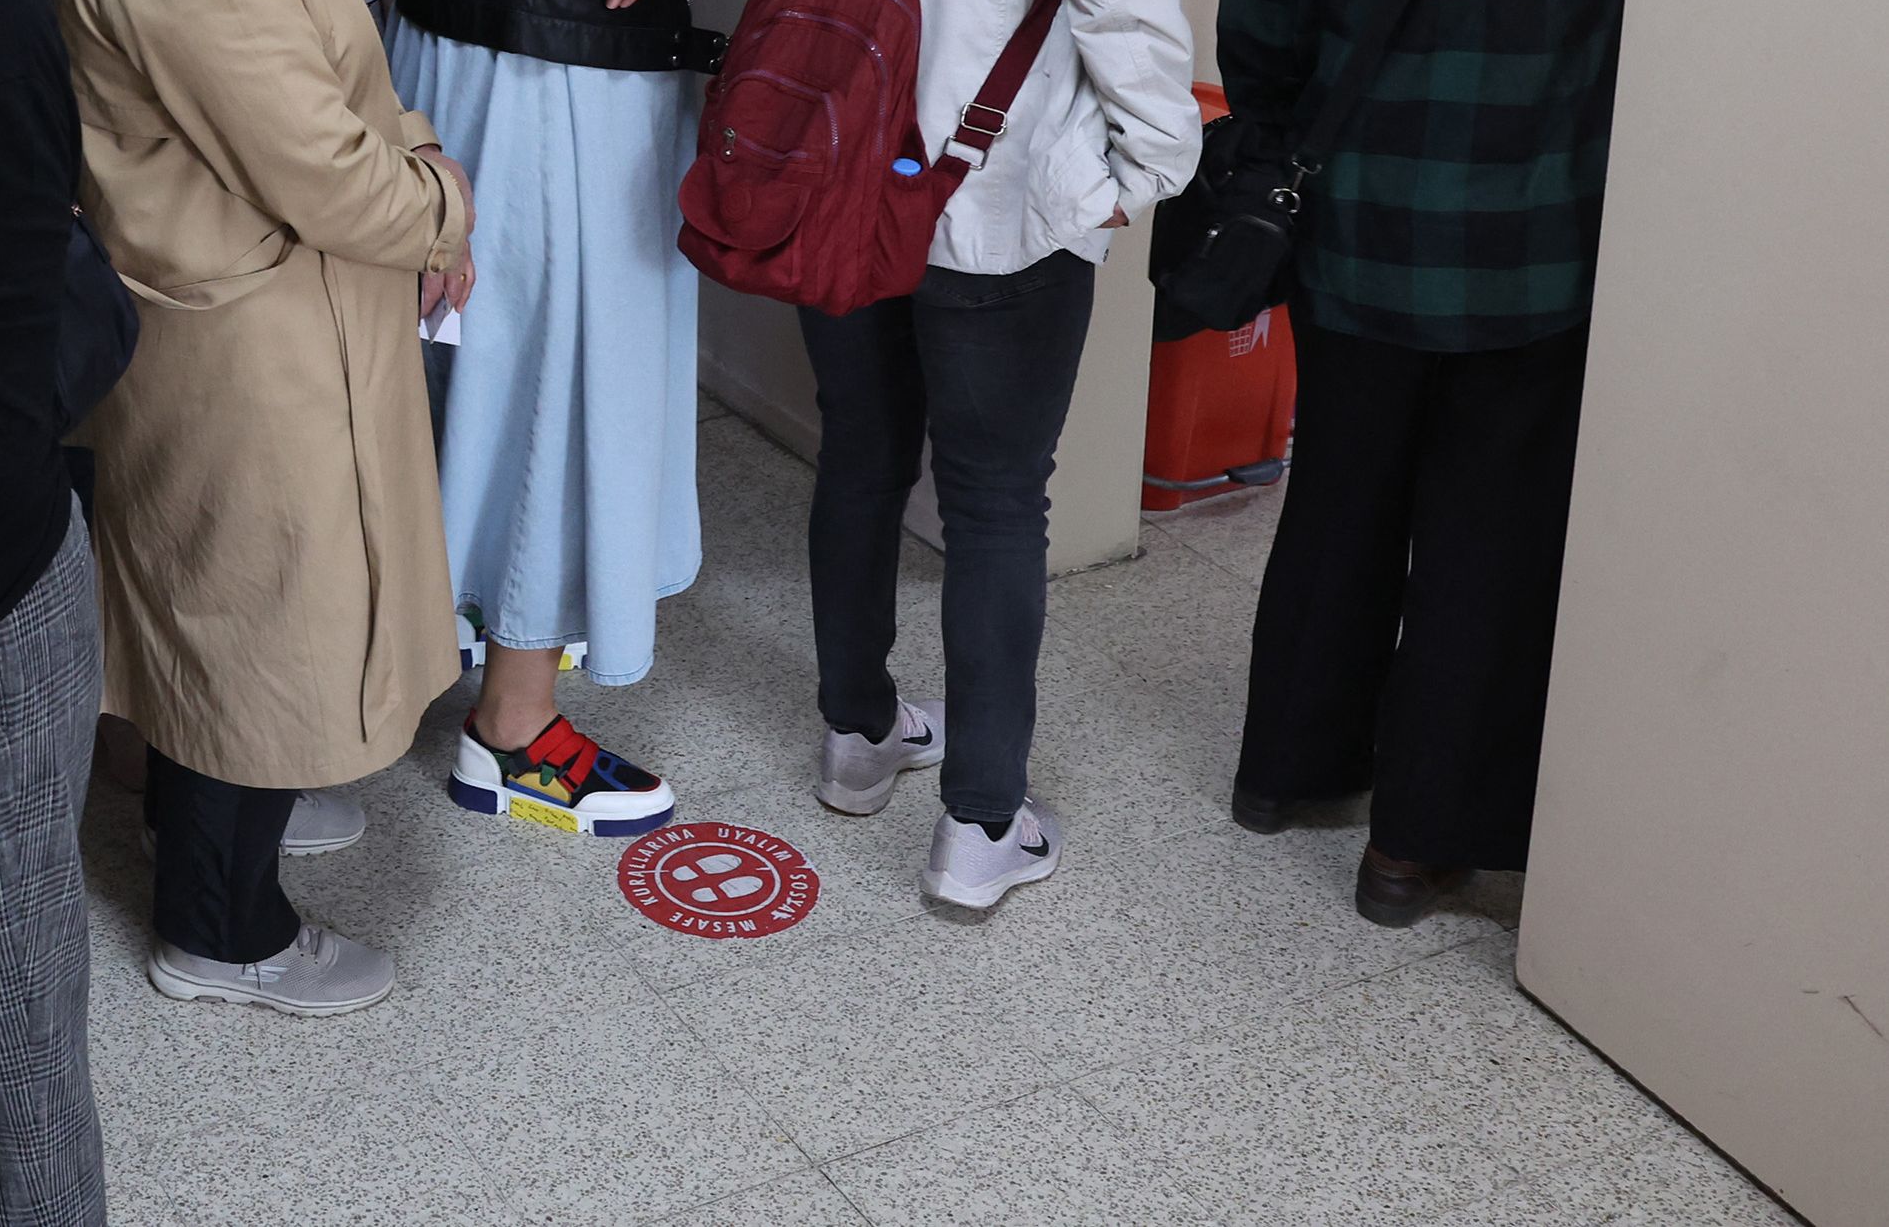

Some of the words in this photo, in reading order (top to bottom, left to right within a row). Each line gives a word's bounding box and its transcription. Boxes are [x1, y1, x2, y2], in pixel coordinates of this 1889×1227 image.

[718, 827, 793, 862] UYALIM
[627, 828, 695, 907] KURALLARINA
[669, 911, 758, 933] MESAFE
